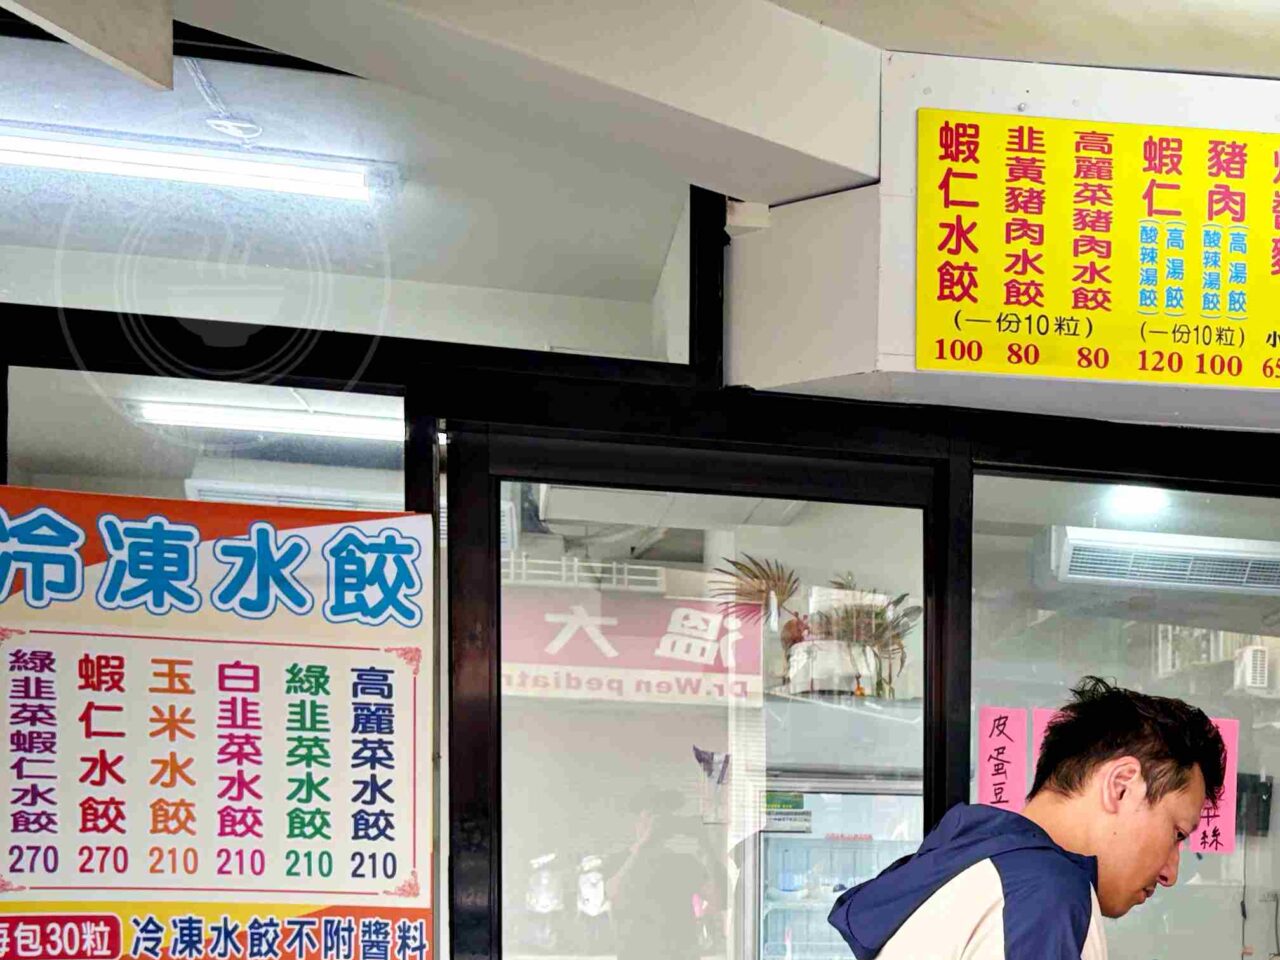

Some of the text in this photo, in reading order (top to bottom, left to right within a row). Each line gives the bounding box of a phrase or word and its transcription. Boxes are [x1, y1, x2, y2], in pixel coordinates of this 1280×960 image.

[937, 121, 980, 304] 蝦仁水餃
[1004, 126, 1046, 308] 韭黃豬肉水餃
[1142, 136, 1183, 217] 蝦仁
[1207, 141, 1248, 223] 豬肉
[1072, 130, 1114, 312] 高麗菜豬肉水餃
[934, 338, 983, 362] 100
[1007, 343, 1040, 366] 80
[1076, 347, 1109, 370] 80
[1138, 350, 1183, 373] 120
[1195, 354, 1242, 377] 100
[0, 510, 420, 625] 冷凍水餃
[9, 649, 58, 834] 綠韭菜蝦仁水餃
[78, 654, 125, 835] 蝦仁水餃
[149, 657, 197, 837] 玉米水餃
[216, 660, 264, 839] 白韭菜水餃
[285, 663, 331, 841] 綠韭菜水餃
[350, 666, 396, 842] 高麗菜水餃
[9, 845, 59, 874] 270
[79, 845, 129, 874] 270
[149, 846, 199, 875] 210
[216, 847, 266, 876] 210
[285, 849, 334, 878] 210
[350, 851, 397, 879] 210
